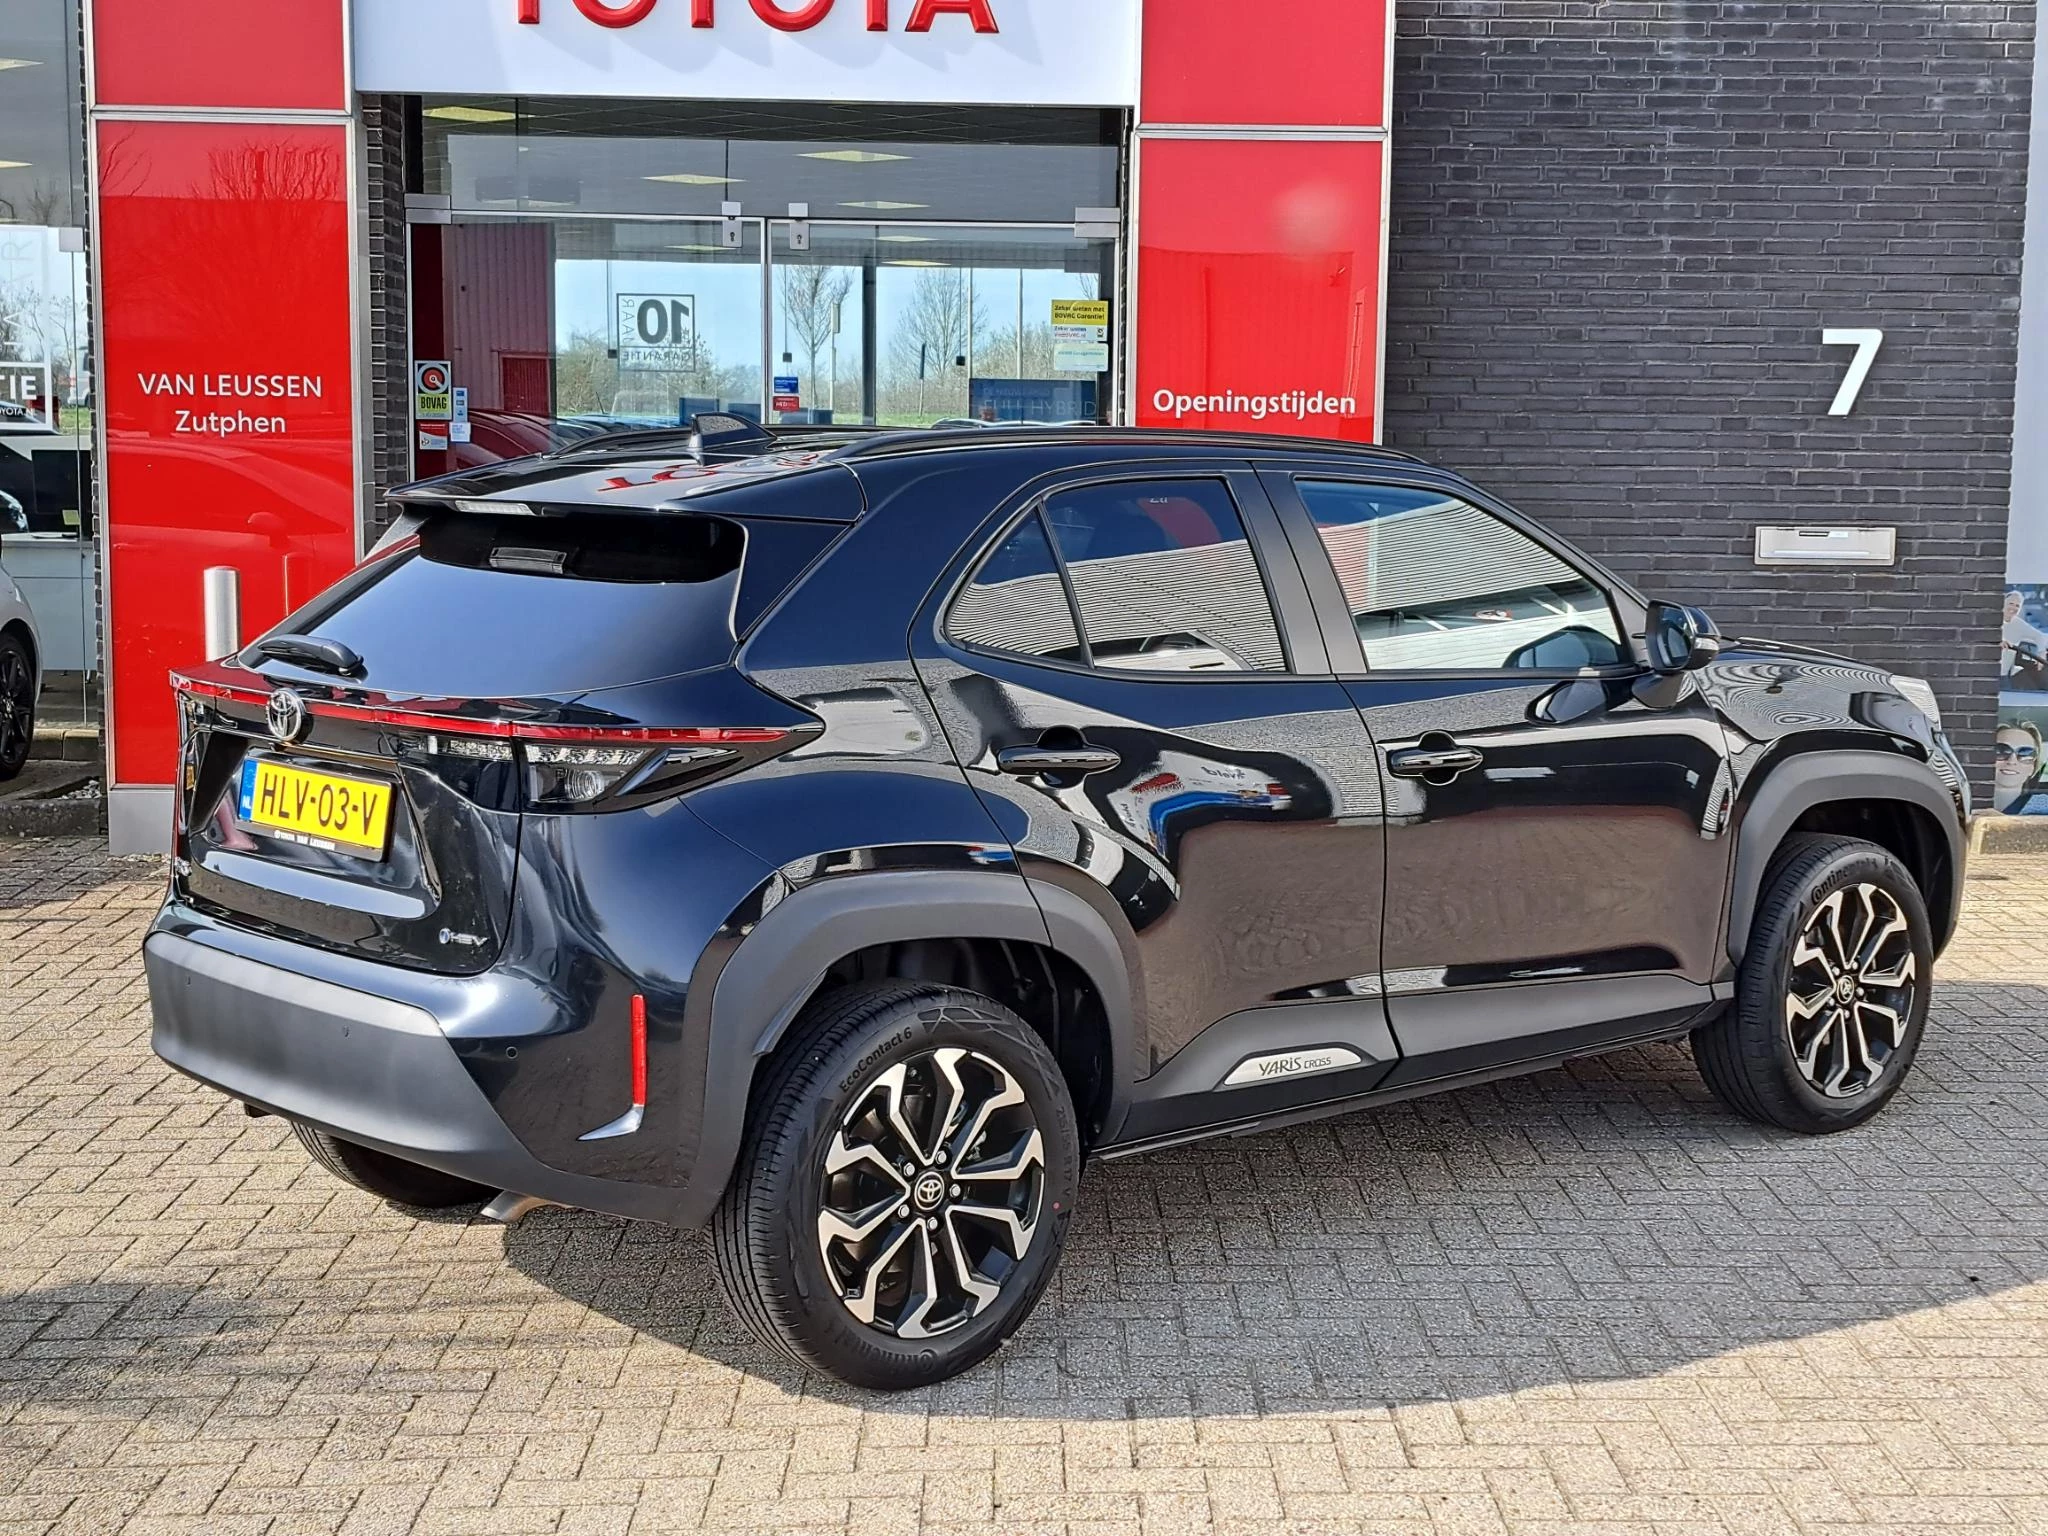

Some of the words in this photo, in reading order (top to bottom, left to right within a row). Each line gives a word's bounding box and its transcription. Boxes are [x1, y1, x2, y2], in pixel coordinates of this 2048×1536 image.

[1822, 328, 1884, 416] 7
[0, 375, 37, 400] IE
[137, 373, 195, 396] VAN
[203, 374, 322, 398] LEUSSEN
[420, 396, 448, 410] BOVAG
[1031, 400, 1097, 416] HYBRID
[1152, 389, 1357, 421] Openingstijden
[175, 410, 286, 436] Zutphen
[260, 772, 379, 836] HLV-03-V
[450, 931, 488, 946] HEV
[838, 1031, 903, 1093] EcoContact
[903, 1026, 913, 1040] 6
[1303, 1057, 1332, 1070] CROSS
